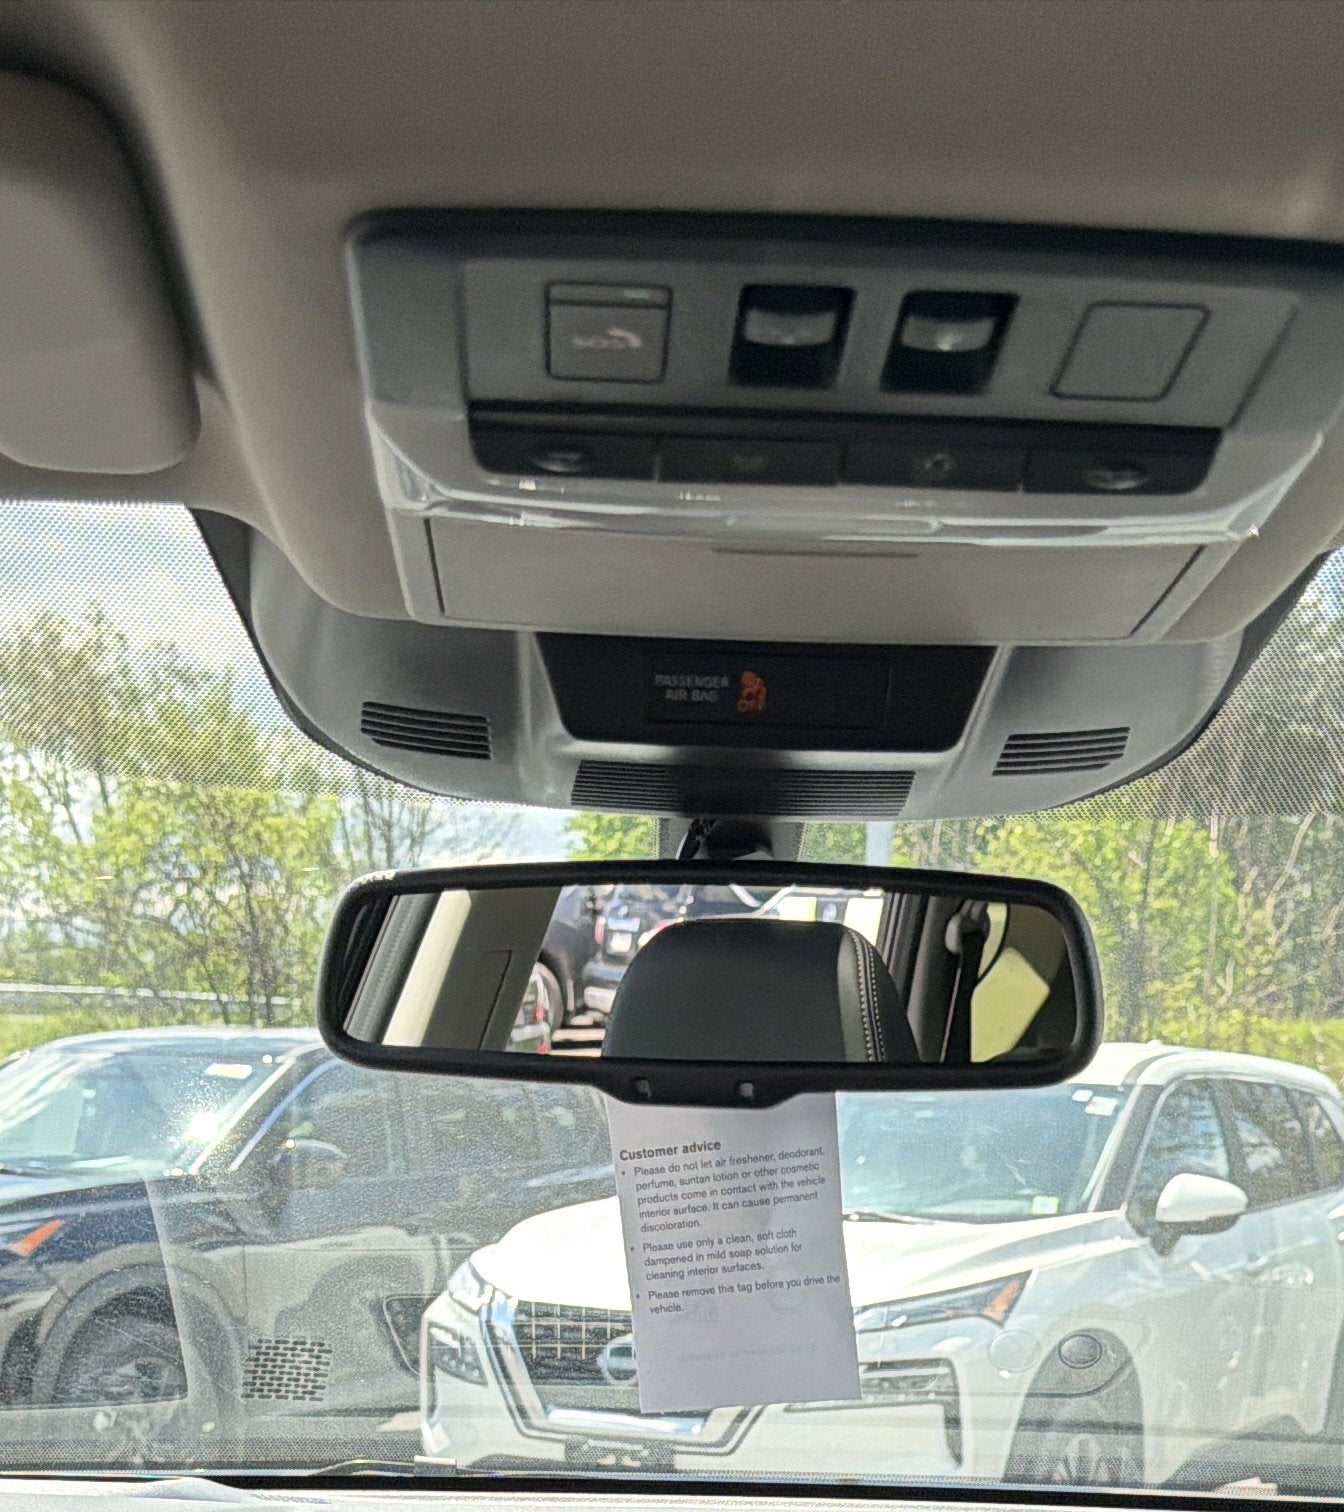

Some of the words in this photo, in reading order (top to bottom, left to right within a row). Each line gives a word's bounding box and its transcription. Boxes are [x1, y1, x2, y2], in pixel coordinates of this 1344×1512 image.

[619, 1144, 677, 1160] Customer
[681, 1139, 722, 1153] advice
[633, 1164, 665, 1176] Please
[667, 1162, 681, 1172] do
[683, 1160, 697, 1170] not
[700, 1159, 712, 1169] let
[714, 1157, 727, 1167] air
[712, 1171, 738, 1180] lotion
[753, 1167, 778, 1176] other
[780, 1162, 819, 1173] cosmetic
[636, 1192, 678, 1204] products
[709, 1187, 718, 1196] in
[720, 1184, 756, 1194] contact
[758, 1181, 778, 1191] with
[780, 1179, 794, 1188] the
[796, 1176, 826, 1186] vehicle
[638, 1207, 670, 1217] interior
[772, 1193, 818, 1205] permanent
[642, 1241, 674, 1251] Please
[695, 1237, 715, 1248] only
[775, 1228, 796, 1238] cloth
[643, 1254, 693, 1266] dampened
[695, 1252, 704, 1260] in
[706, 1250, 726, 1259] mild
[728, 1249, 752, 1259] soap
[791, 1242, 802, 1251] for
[645, 1269, 685, 1281] cleaning
[686, 1265, 719, 1275] interior
[647, 1289, 679, 1299] Please
[681, 1287, 715, 1296] remove
[717, 1284, 735, 1293] this
[736, 1282, 753, 1293] tag
[755, 1279, 784, 1289] before
[786, 1279, 801, 1288] you
[803, 1275, 824, 1285] drive
[826, 1274, 840, 1283] the
